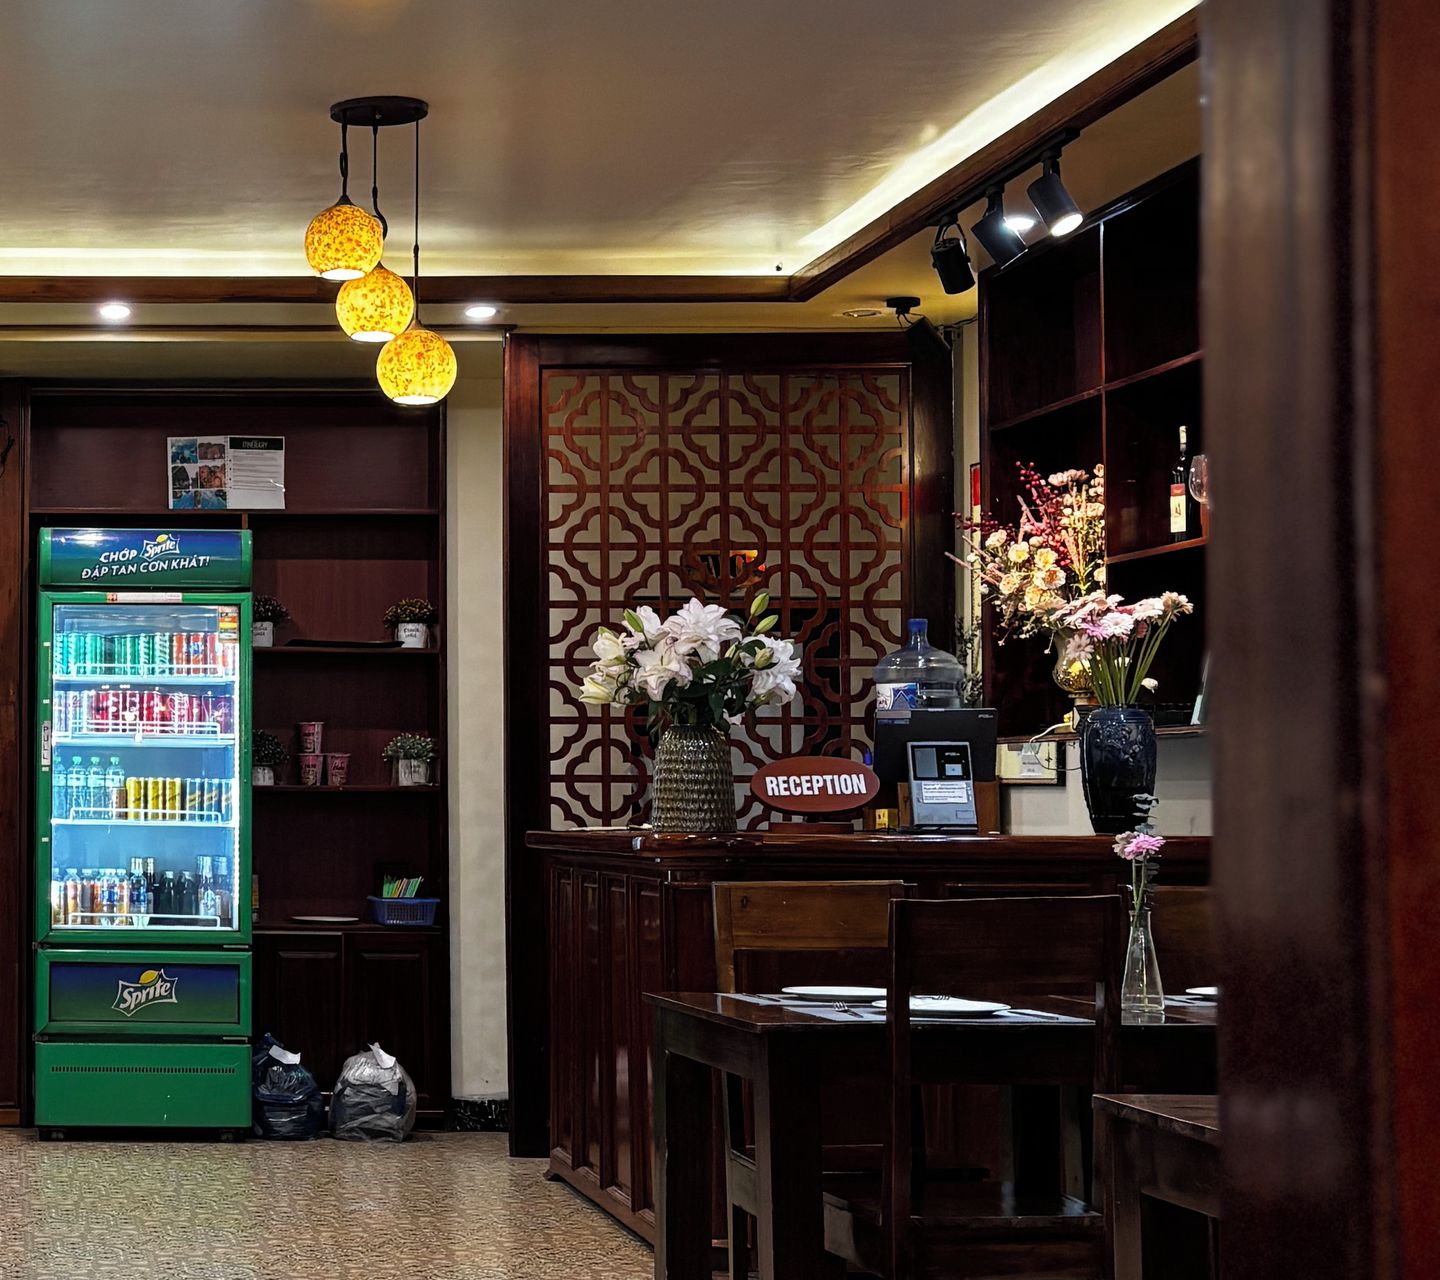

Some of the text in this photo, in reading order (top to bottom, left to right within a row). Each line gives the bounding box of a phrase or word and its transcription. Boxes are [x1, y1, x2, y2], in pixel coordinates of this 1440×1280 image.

[99, 539, 177, 563] CHỚP Sprite
[111, 564, 137, 576] TAN
[139, 560, 168, 573] CƠN
[170, 554, 210, 570] KHÁT!
[765, 773, 867, 796] RECEPTION
[119, 978, 172, 1010] Sprite
